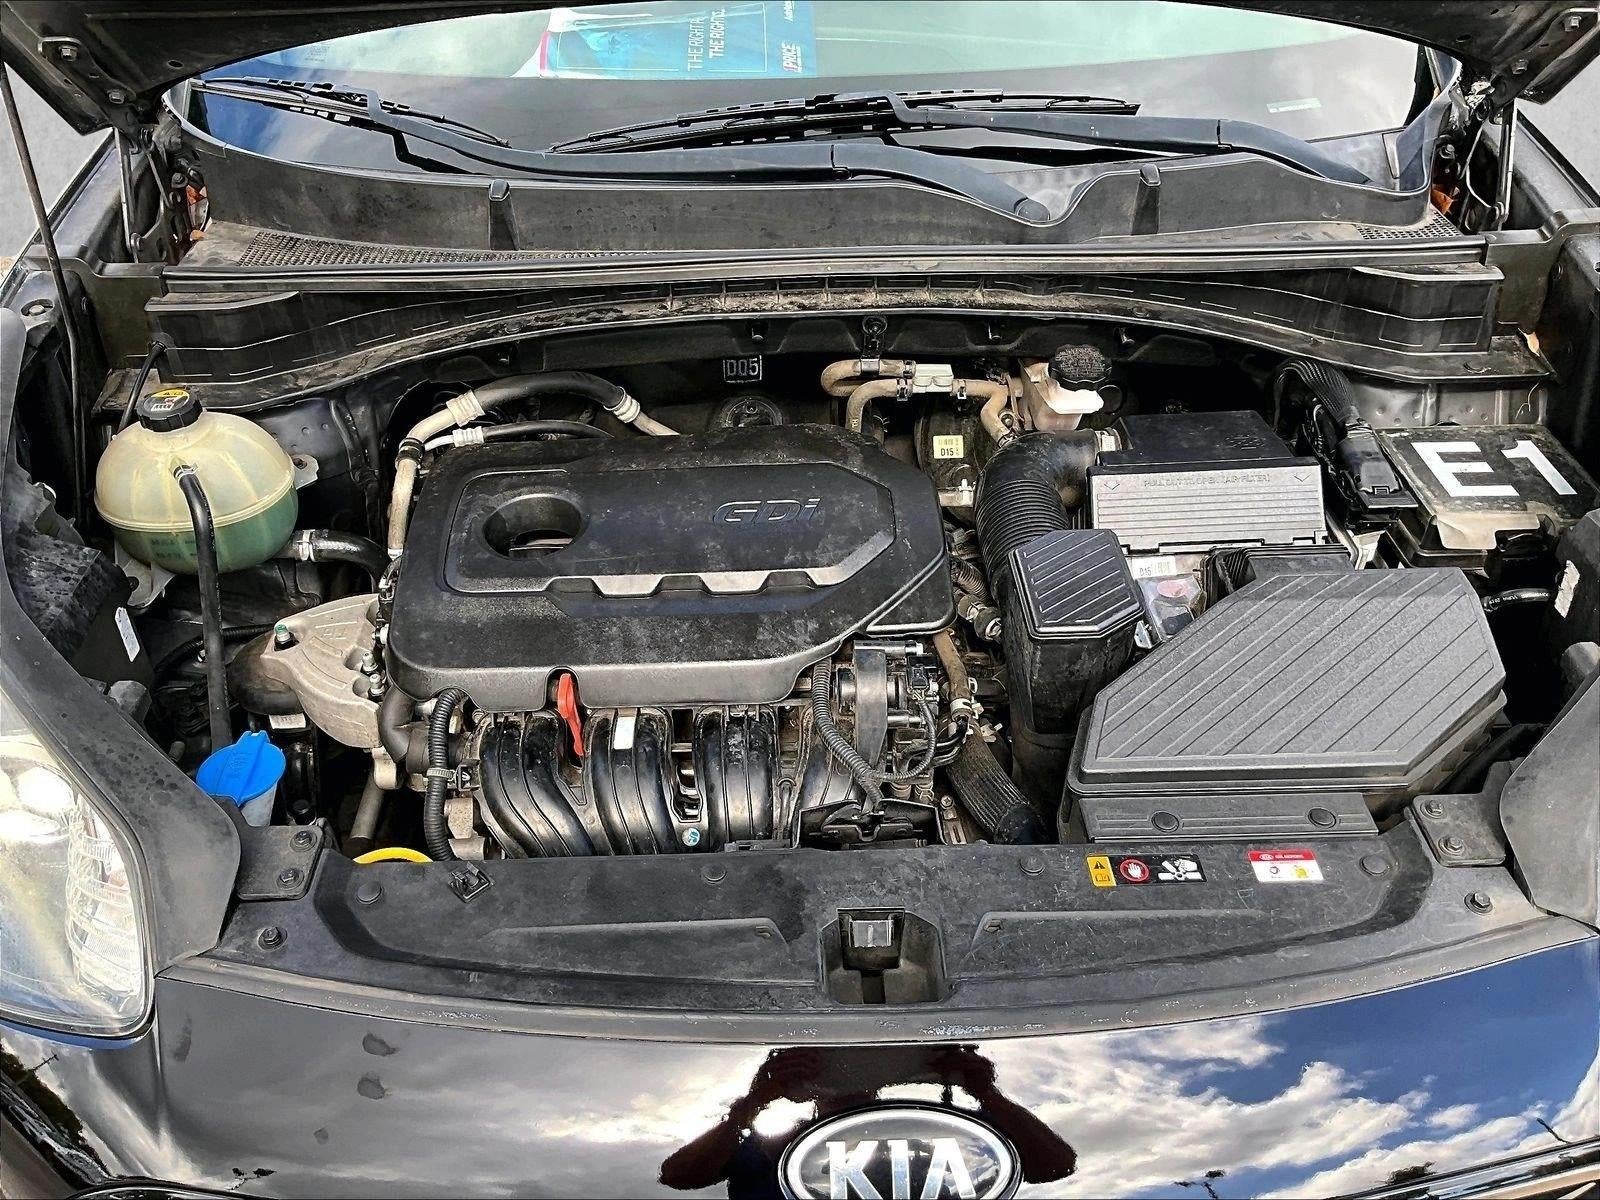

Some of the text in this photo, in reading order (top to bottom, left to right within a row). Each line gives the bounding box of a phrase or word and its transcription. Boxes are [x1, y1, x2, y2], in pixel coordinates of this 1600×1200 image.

[688, 24, 705, 47] RIGHT
[687, 47, 703, 72] THE
[709, 39, 725, 59] THE
[825, 1137, 977, 1200] KIA
